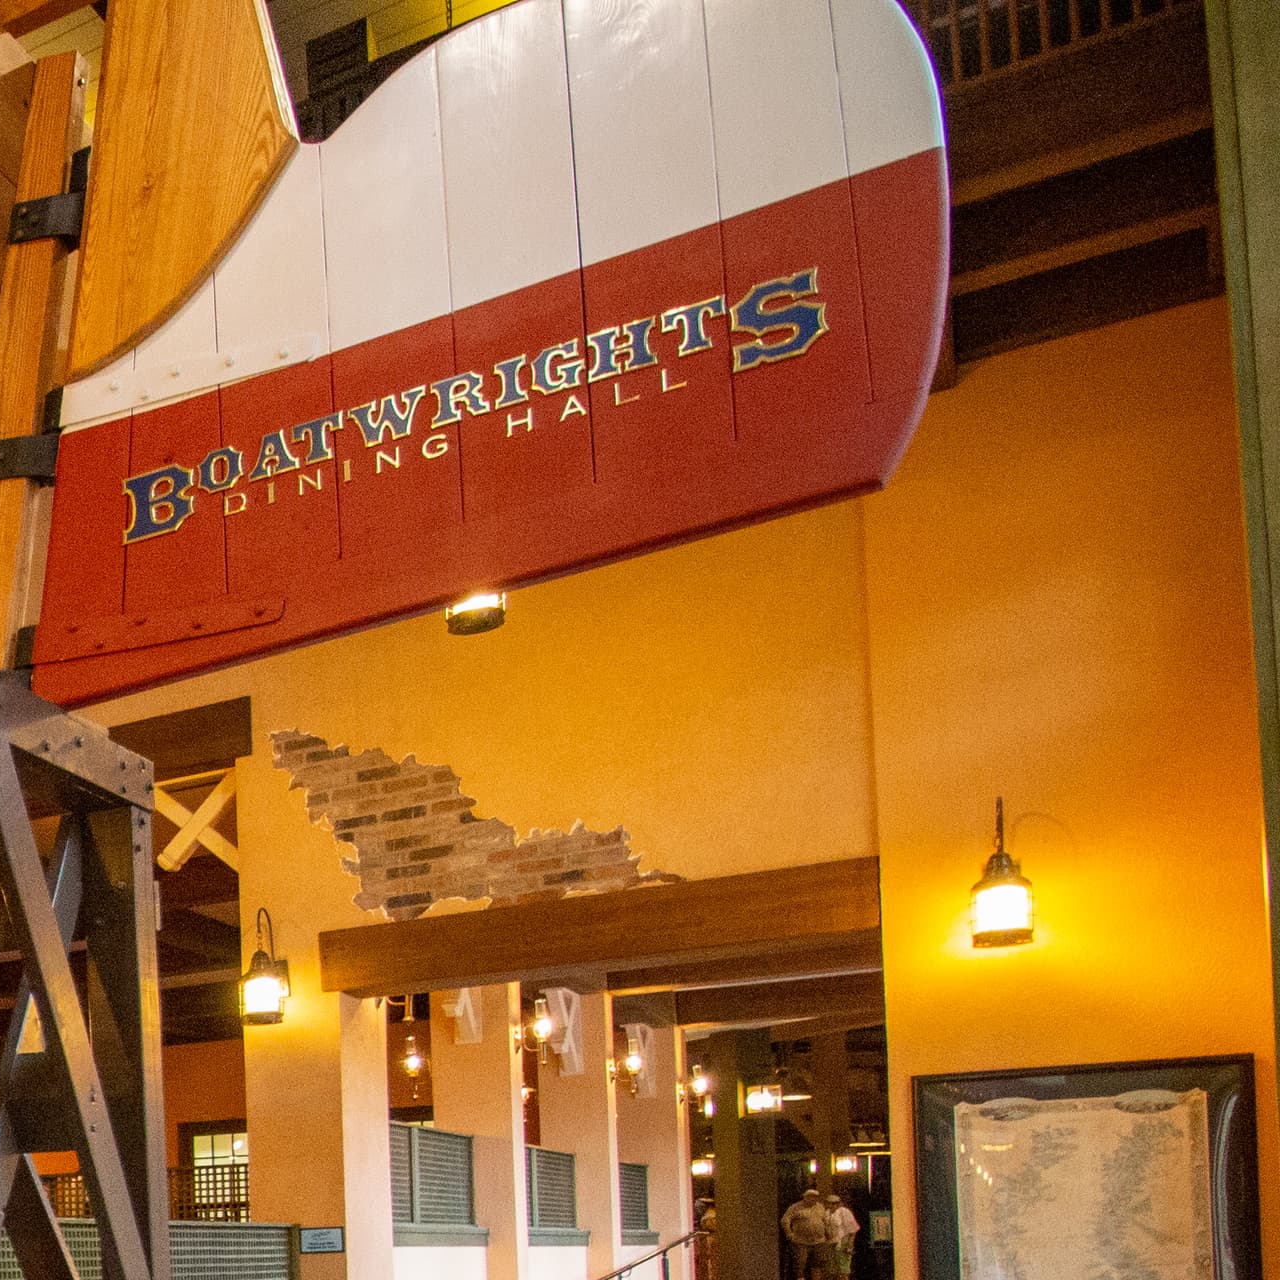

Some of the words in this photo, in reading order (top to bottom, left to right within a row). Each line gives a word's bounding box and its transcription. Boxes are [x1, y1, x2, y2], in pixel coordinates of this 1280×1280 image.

[122, 267, 830, 545] BOATWRIGHTS
[223, 433, 450, 518] DINING
[507, 368, 688, 437] HALL
